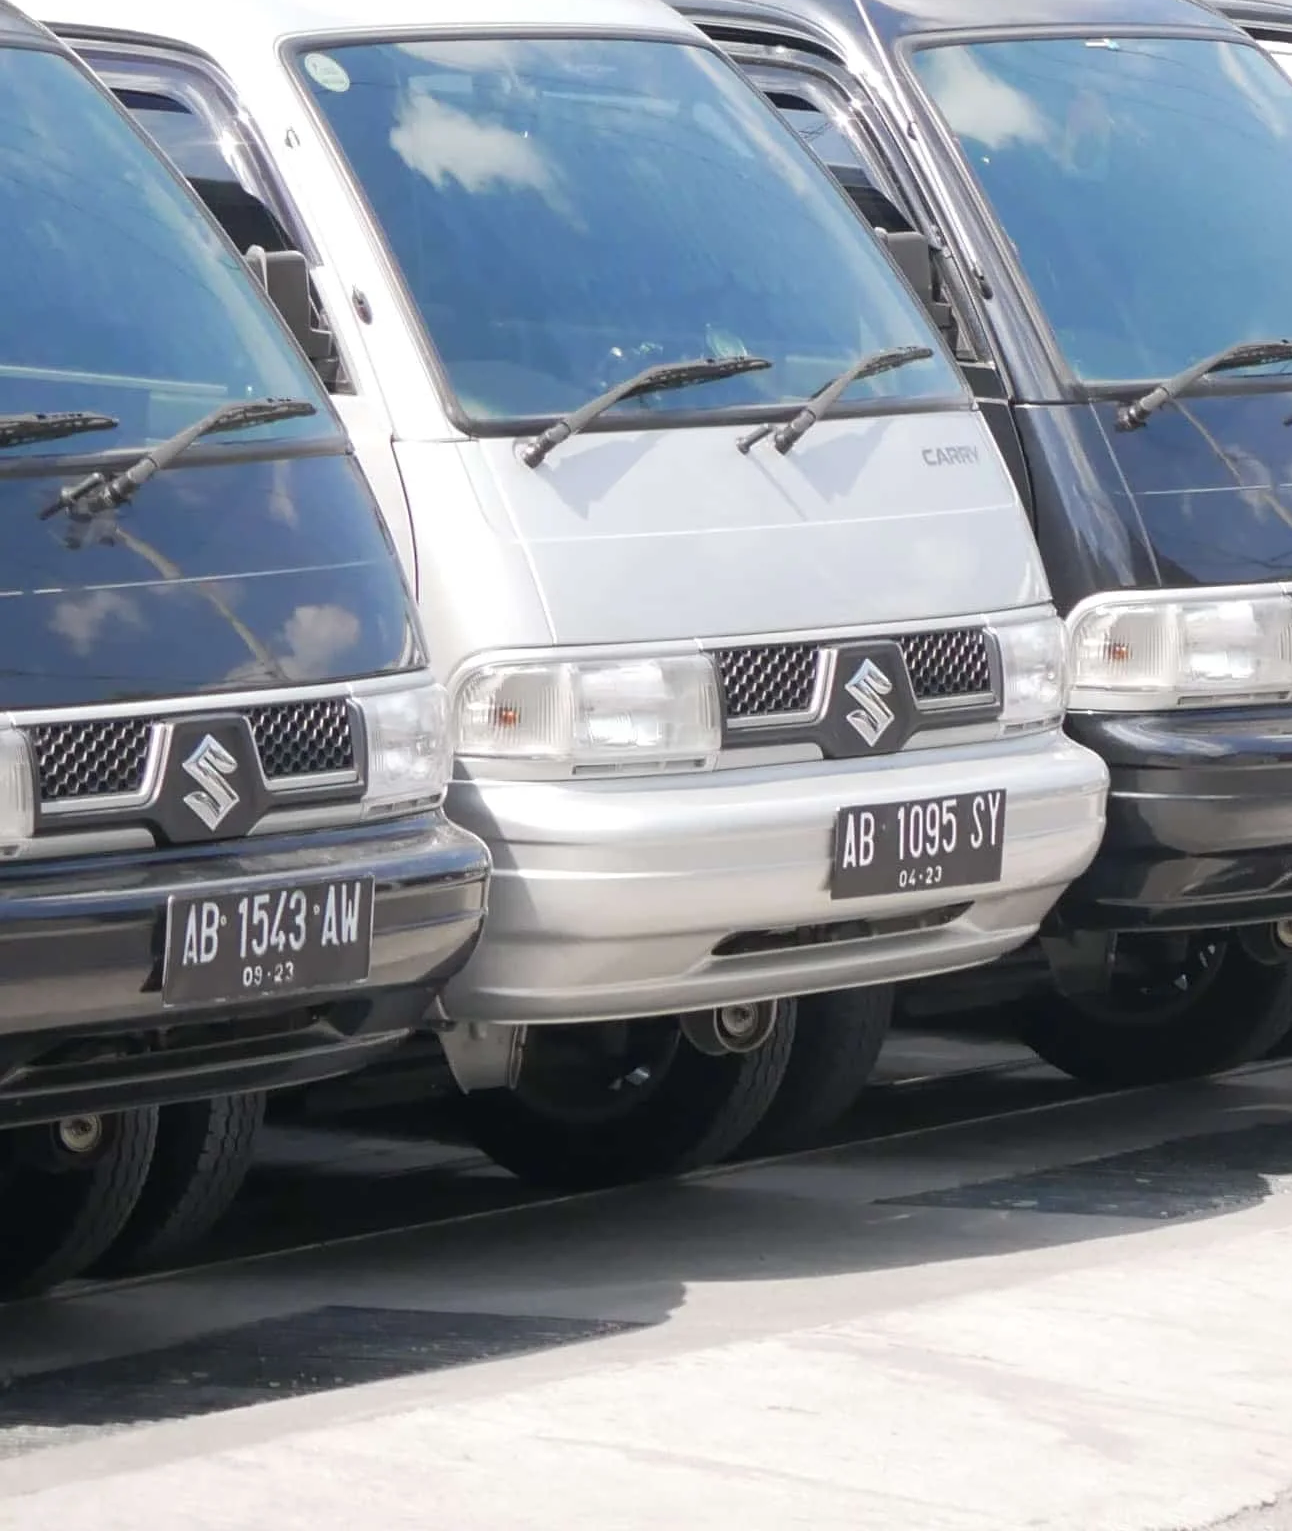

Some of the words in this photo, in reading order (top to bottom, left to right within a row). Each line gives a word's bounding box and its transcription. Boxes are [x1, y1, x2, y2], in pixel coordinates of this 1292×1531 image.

[922, 445, 979, 466] CARRY
[842, 811, 875, 869] AB
[898, 798, 957, 860] 1095
[970, 791, 1000, 848] SY
[182, 902, 220, 966] AB
[238, 890, 306, 959] 1543
[321, 881, 361, 947] AW
